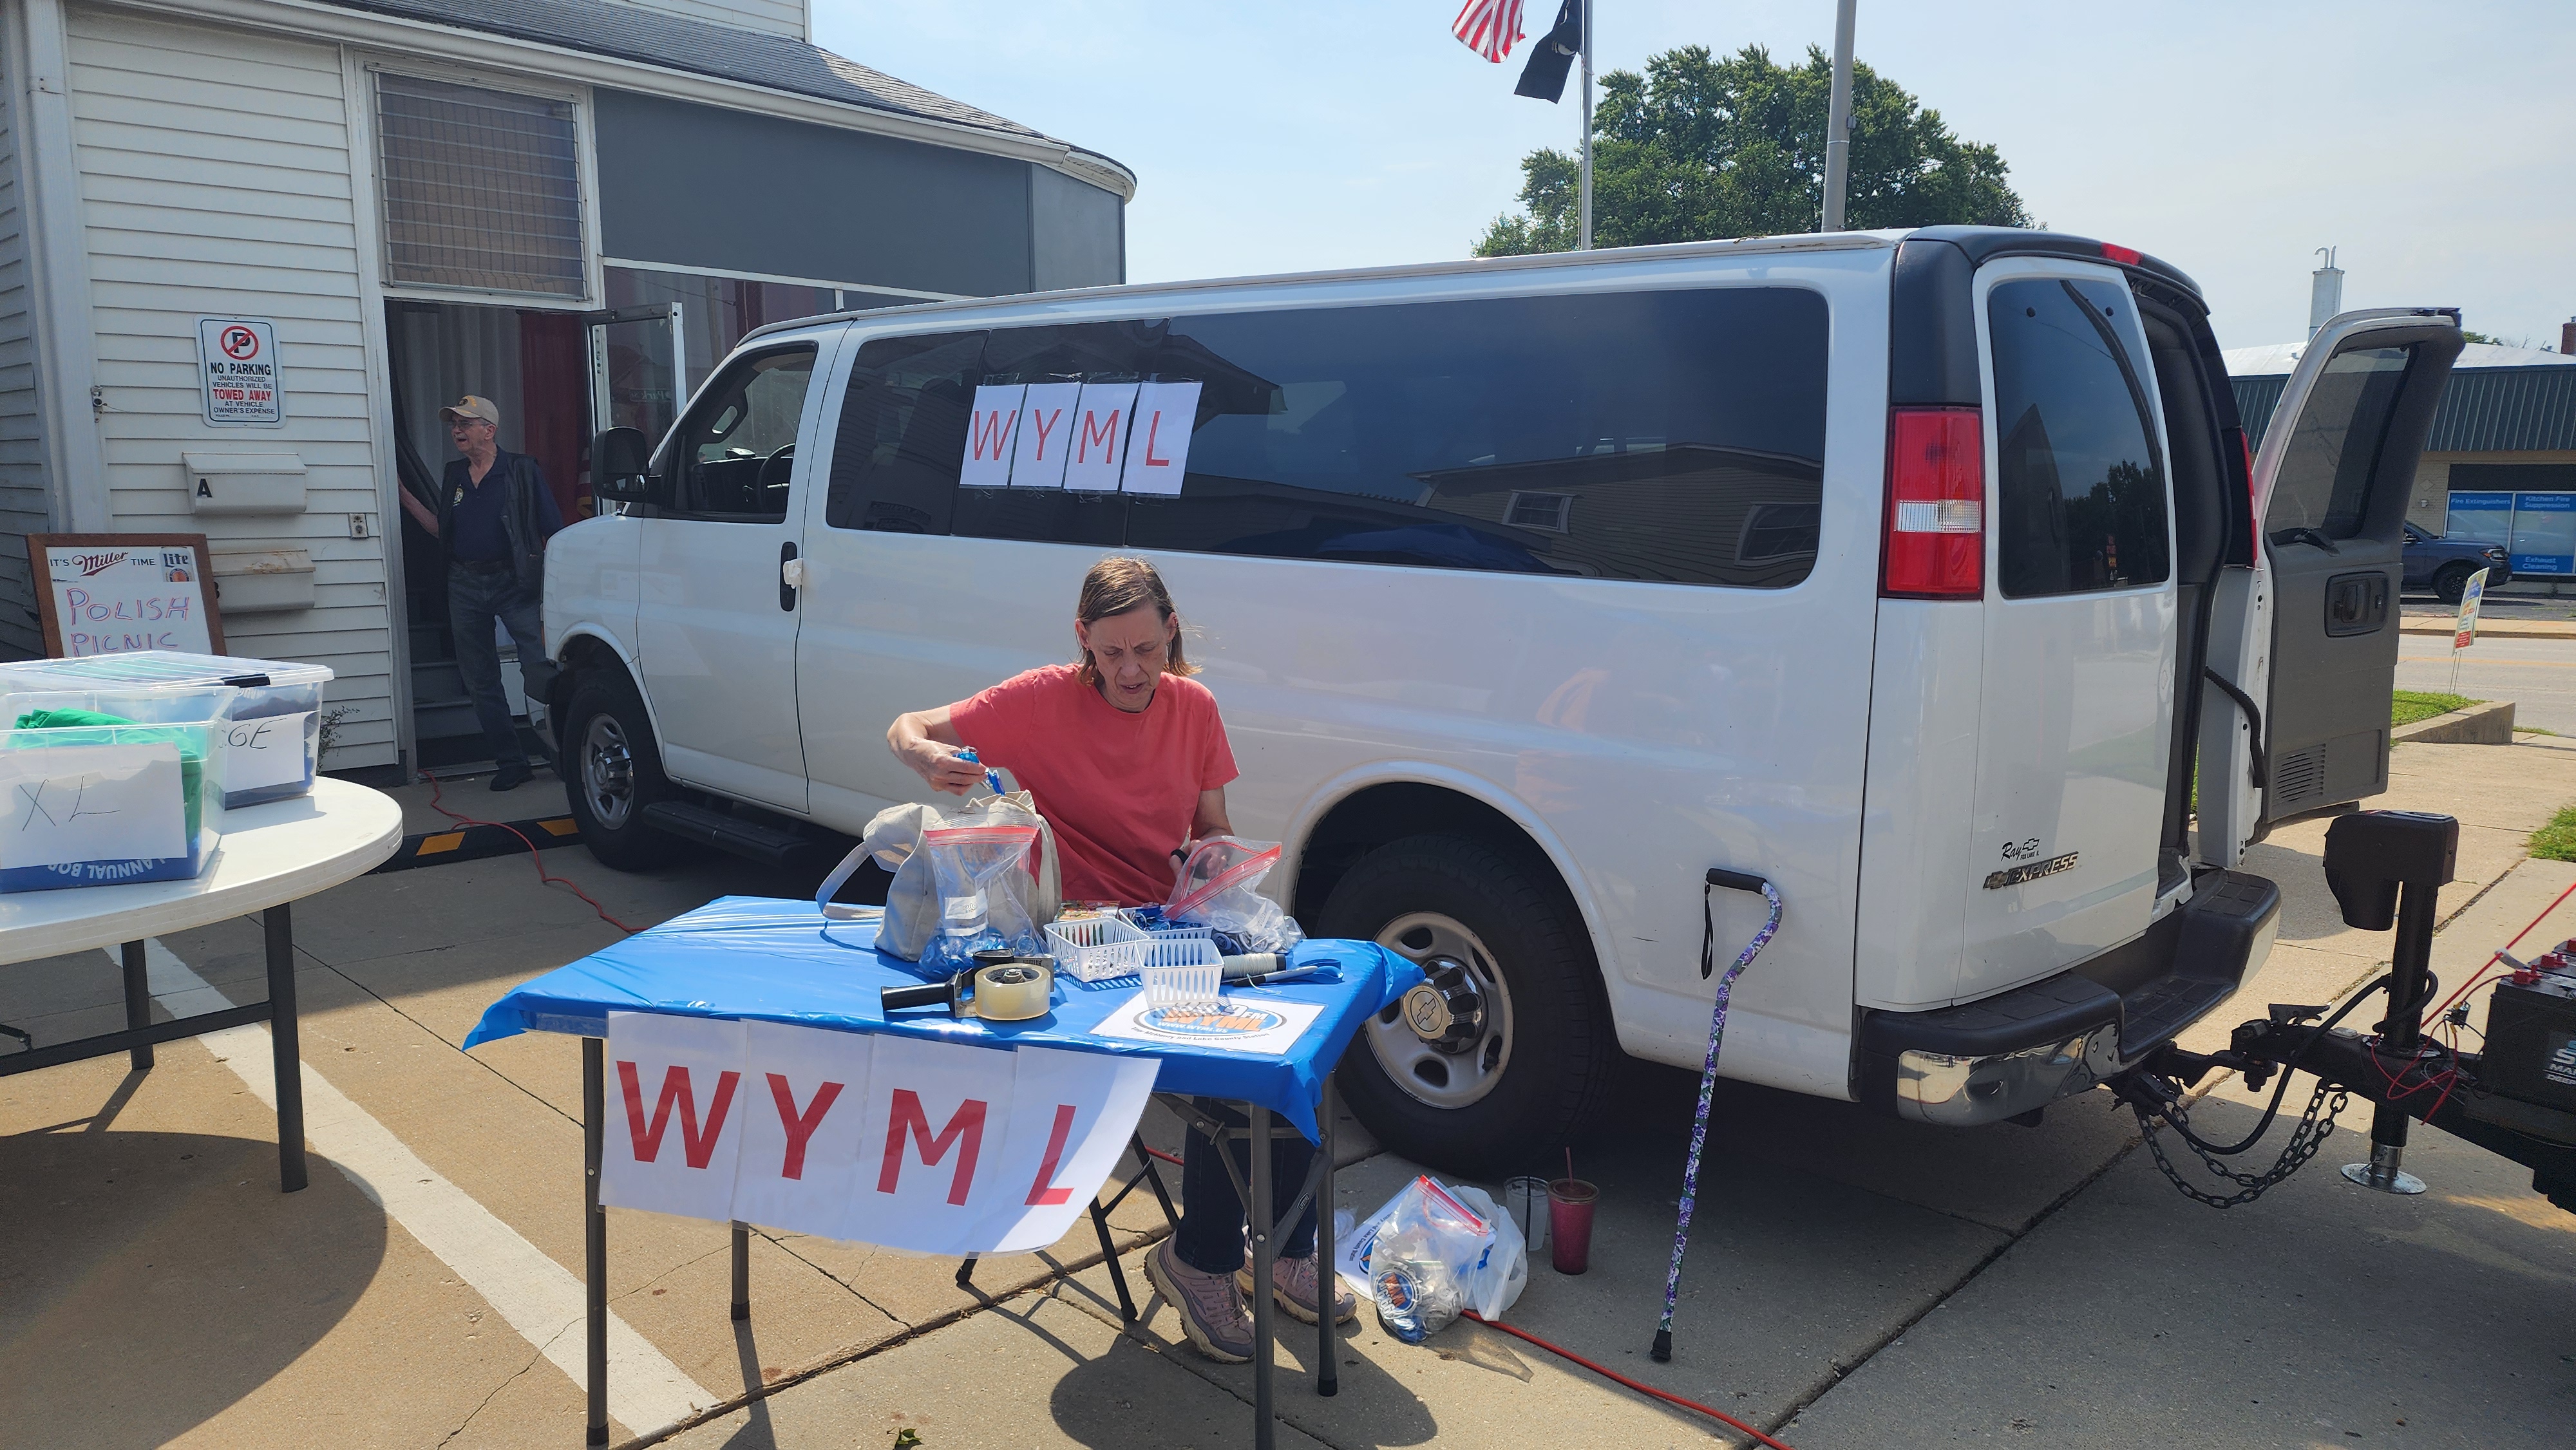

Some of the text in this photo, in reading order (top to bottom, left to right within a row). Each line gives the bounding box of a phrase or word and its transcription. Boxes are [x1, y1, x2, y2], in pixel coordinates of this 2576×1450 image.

[210, 362, 272, 376] NO PARKING
[213, 388, 271, 401] TOWED AWAY
[974, 408, 1170, 467] WYML
[196, 478, 213, 498] A
[71, 552, 129, 575] Miller
[162, 553, 189, 568] Lite
[2522, 563, 2558, 571] Cleaning
[66, 588, 189, 626] POLISH
[70, 632, 178, 657] PICNIC
[2001, 842, 2022, 862] Ray
[86, 858, 154, 880] ANNUAL
[2004, 853, 2079, 887] EXPRESS
[1162, 1009, 1264, 1032] WYML
[1241, 1011, 1270, 1021] FM
[615, 1060, 1077, 1207] WYML
